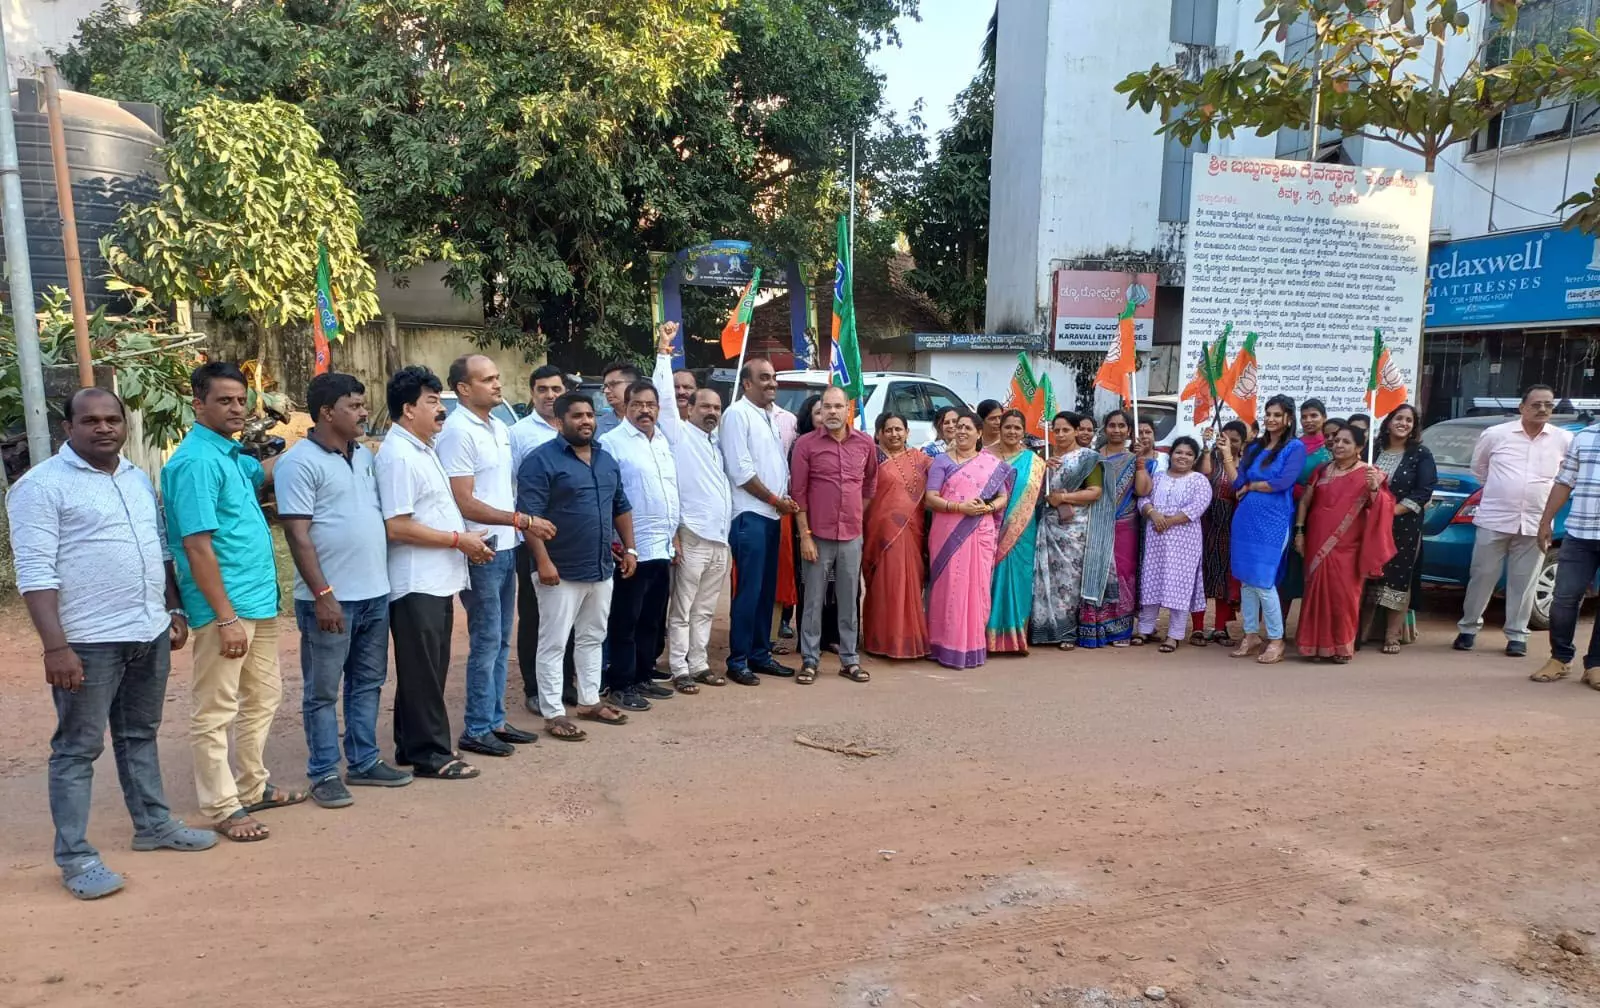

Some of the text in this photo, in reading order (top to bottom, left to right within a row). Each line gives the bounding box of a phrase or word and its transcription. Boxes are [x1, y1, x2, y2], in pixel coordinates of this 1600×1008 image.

[1208, 155, 1228, 176] ಶ್ರೀ
[1428, 238, 1543, 280] relaxwell
[1427, 276, 1541, 298] MATTRESSES
